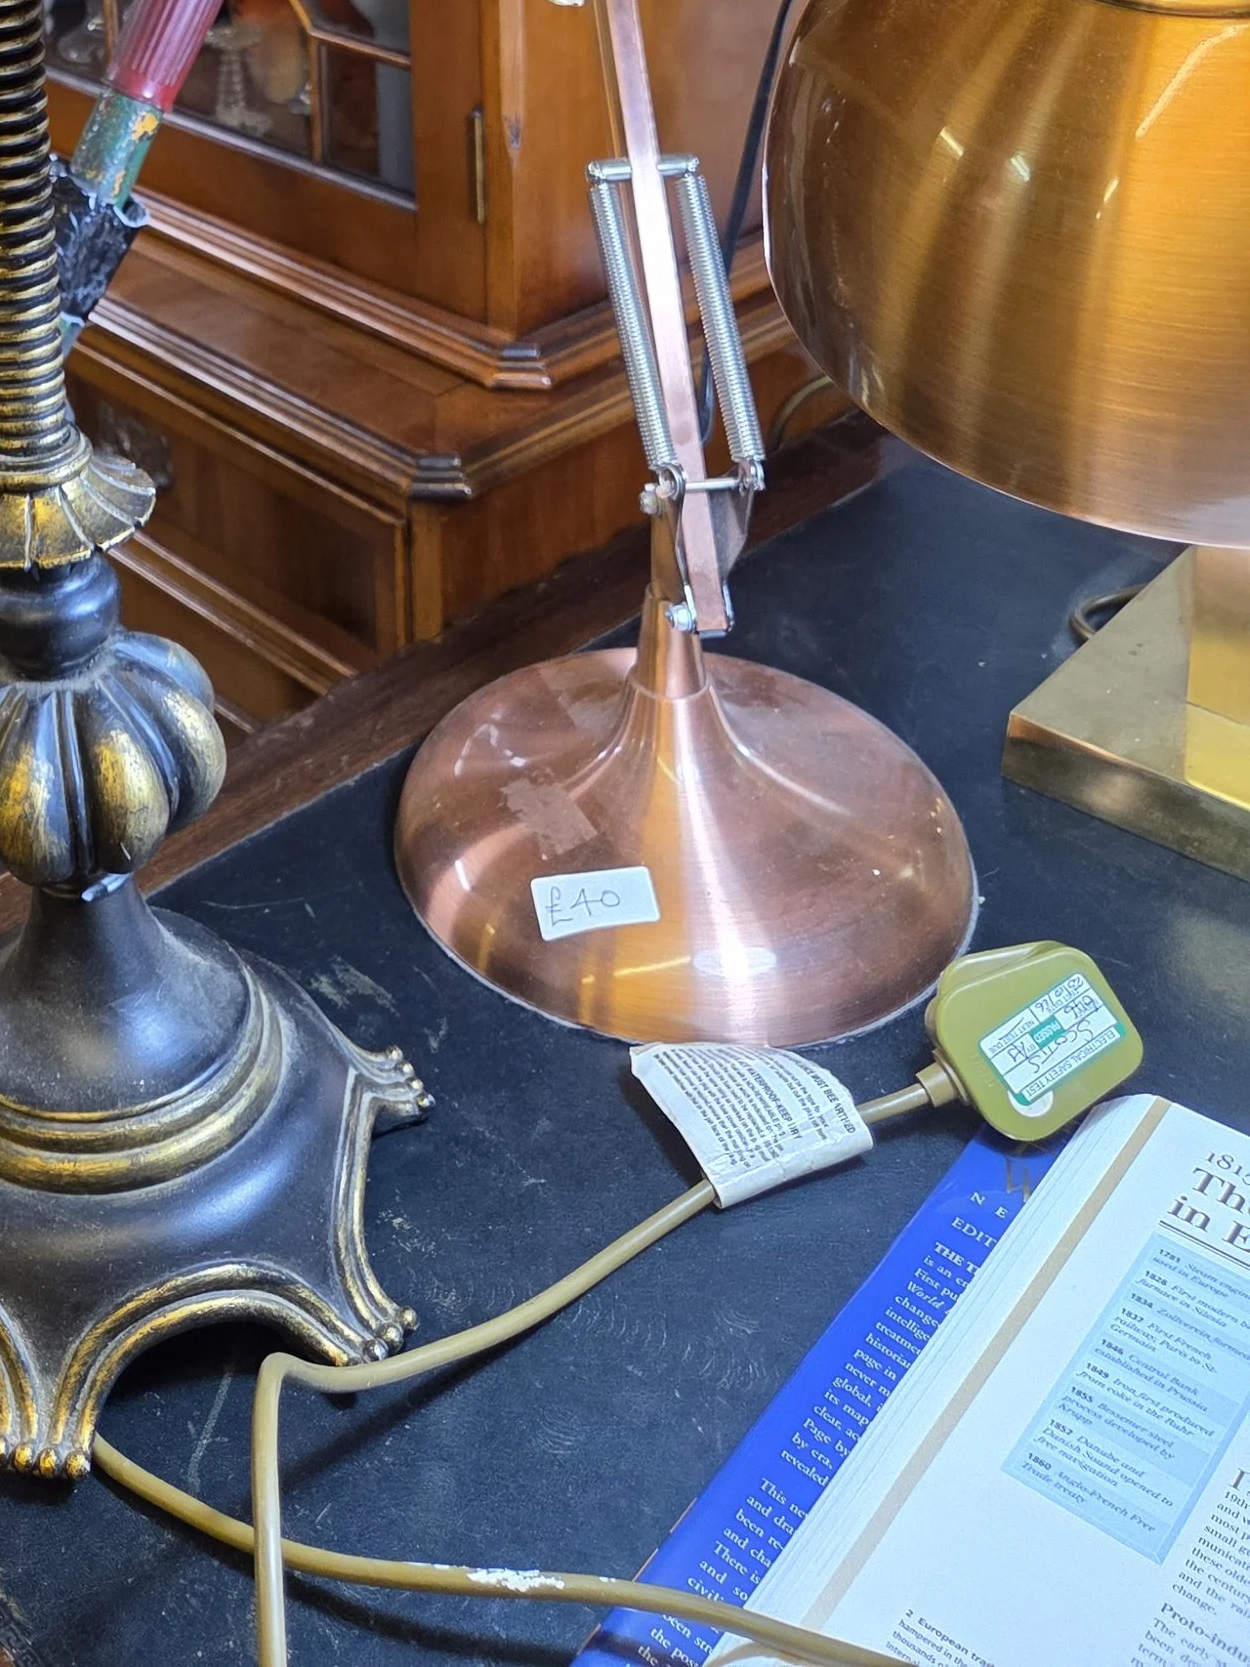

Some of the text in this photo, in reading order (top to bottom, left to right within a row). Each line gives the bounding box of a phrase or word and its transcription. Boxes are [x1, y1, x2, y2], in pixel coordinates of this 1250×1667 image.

[545, 885, 620, 926] £40
[988, 1040, 1004, 1054] DUE
[1026, 1029, 1117, 1097] ELECTRICAL SAFETY TEST
[1192, 1166, 1250, 1214] Th
[1167, 1195, 1208, 1233] in
[923, 1255, 952, 1278] is an
[935, 1242, 964, 1266] THE
[1160, 1249, 1181, 1263] 1781
[914, 1268, 940, 1290] First
[1178, 1270, 1189, 1278] in
[1190, 1275, 1229, 1298] Europe
[907, 1281, 945, 1309] World
[1131, 1293, 1153, 1308] 1834
[1134, 1278, 1227, 1328] furnace in Silesia
[1145, 1270, 1238, 1324] 1828 First modern
[1110, 1324, 1156, 1352] Germain
[1122, 1308, 1212, 1360] 1837 First French
[853, 1349, 896, 1380] page in
[1102, 1339, 1198, 1396] 1846 Central Bank
[1159, 1340, 1201, 1365] Paris to
[845, 1363, 877, 1387] never
[1094, 1348, 1208, 1412] established in Prussia
[824, 1389, 840, 1405] its
[1075, 1371, 1194, 1436] from coke in the Ruhr
[1086, 1362, 1109, 1378] 1849
[1159, 1406, 1215, 1437] produced
[1058, 1403, 1093, 1425] Krupp
[1061, 1395, 1175, 1460] process developed by
[1071, 1386, 1174, 1448] 1855 Bessemer steel
[803, 1418, 832, 1444] Page
[792, 1432, 833, 1470] by era,
[1033, 1436, 1118, 1487] free navigation
[1050, 1419, 1146, 1478] 1857 Danube and
[781, 1450, 829, 1487] revealed
[1042, 1427, 1173, 1506] Danish Sound opened to
[761, 1478, 787, 1505] This
[1022, 1461, 1087, 1503] Trade treaty
[1028, 1452, 1156, 1531] 1860 Anglo-French Free
[746, 1496, 772, 1518] and
[1216, 1503, 1240, 1519] and
[736, 1508, 764, 1538] been
[1204, 1525, 1237, 1548] small
[1211, 1514, 1239, 1535] most
[724, 1528, 749, 1550] and
[700, 1561, 728, 1584] and
[714, 1540, 760, 1584] There is
[1185, 1559, 1204, 1575] the
[1192, 1547, 1223, 1569] these
[1172, 1584, 1217, 1615] change.
[1178, 1572, 1226, 1603] and the
[650, 1628, 671, 1648] the
[898, 1619, 943, 1653] hampered
[943, 1648, 953, 1660] in
[906, 1608, 969, 1655] 2 European
[1145, 1630, 1174, 1654] been
[1153, 1617, 1176, 1638] The
[637, 1645, 659, 1666] the
[892, 1631, 937, 1665] thousands
